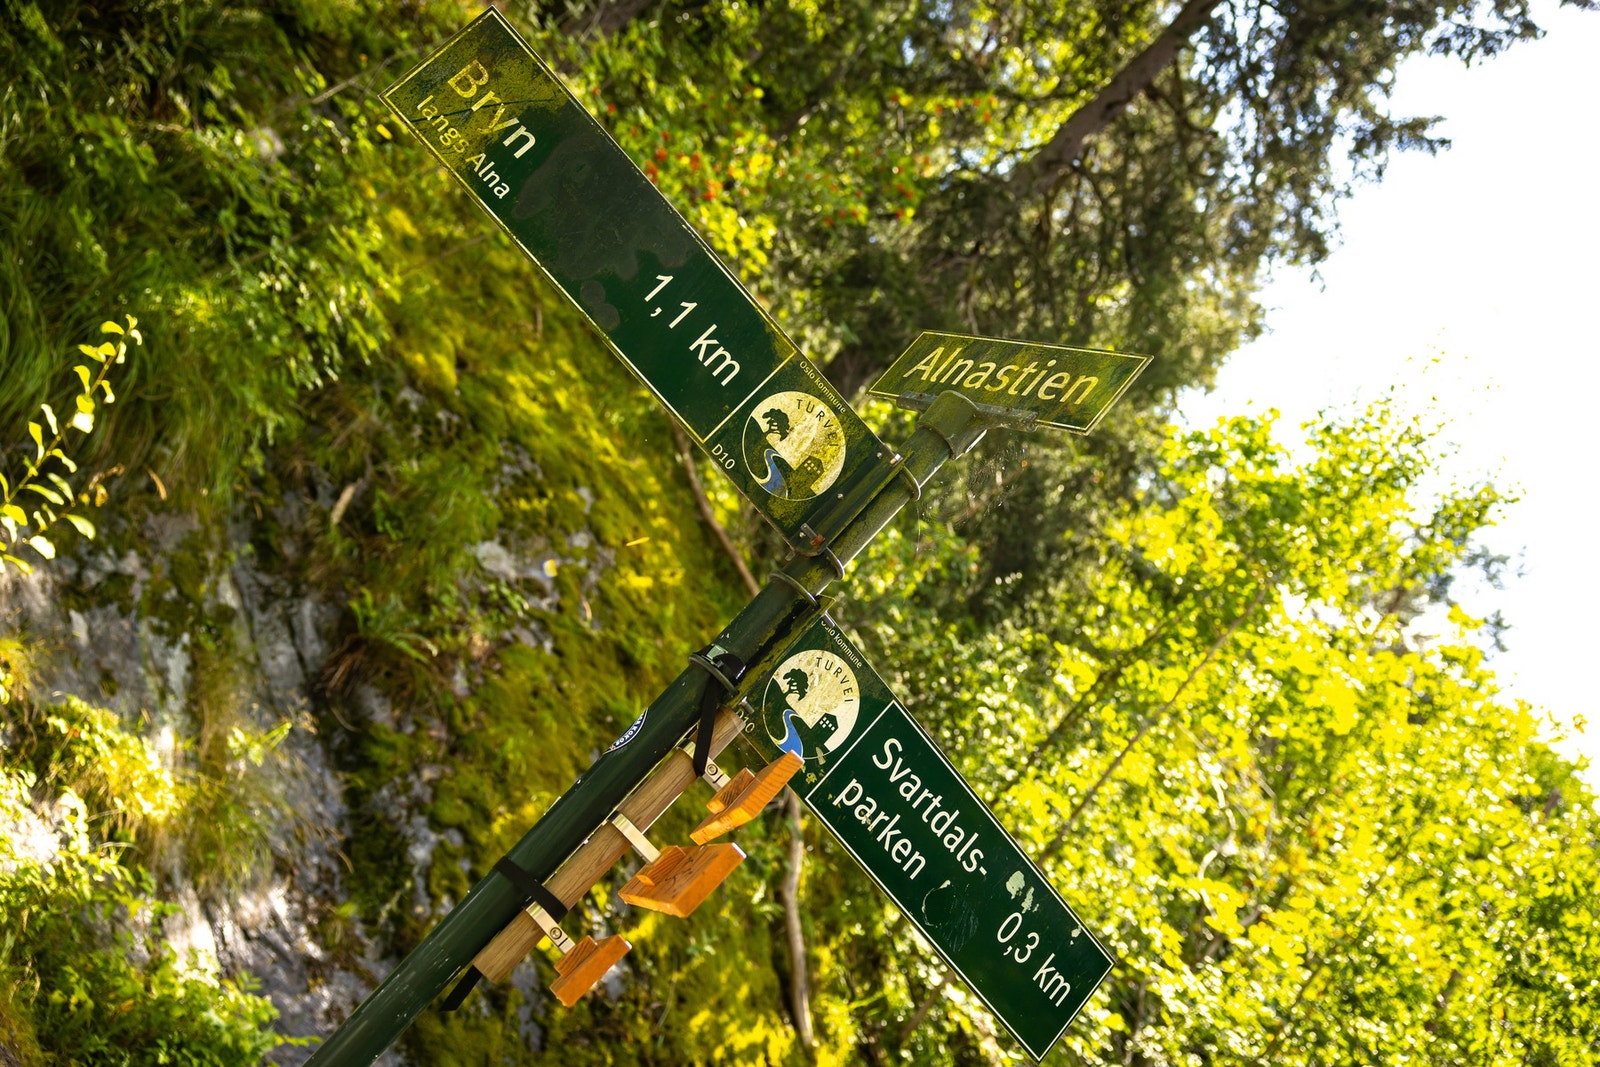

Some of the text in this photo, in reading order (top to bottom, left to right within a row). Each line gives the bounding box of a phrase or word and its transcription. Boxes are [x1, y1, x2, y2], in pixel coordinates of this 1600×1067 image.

[416, 94, 510, 200] langs Alna
[447, 59, 536, 159] Bryn
[644, 274, 741, 387] 1,1 km
[799, 360, 847, 414] Oslo kommune
[902, 346, 1100, 405] Alnastien
[711, 443, 736, 470] D10
[796, 398, 839, 447] TURVEI
[816, 656, 854, 702] TURVEI
[833, 633, 863, 669] kommune
[832, 778, 926, 880] parken
[872, 737, 988, 877] Svartdals-
[996, 911, 1072, 1007] 0,3 km
